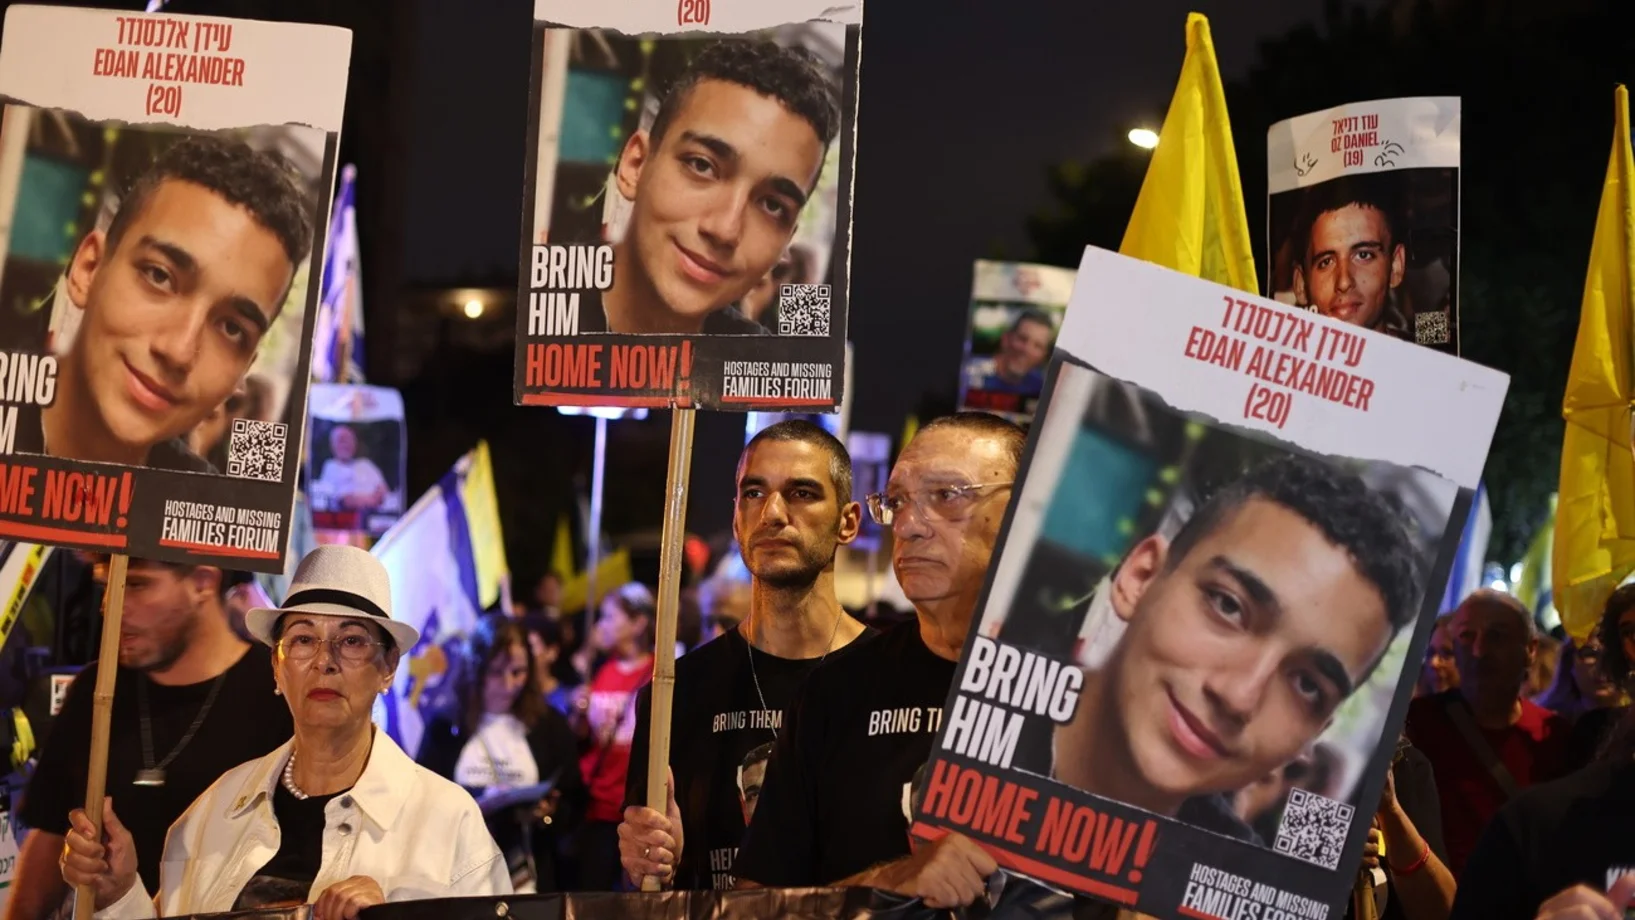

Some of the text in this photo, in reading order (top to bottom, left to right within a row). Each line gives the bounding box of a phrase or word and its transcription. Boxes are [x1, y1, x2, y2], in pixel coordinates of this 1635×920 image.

[677, 0, 710, 26] (20)
[116, 16, 233, 53] עידן אלכסנדר
[93, 48, 245, 86] EDAN ALEXANDER
[146, 83, 182, 118] (20)
[1331, 131, 1379, 153] OZ DANIEL
[1332, 114, 1378, 136] עוז דניאל
[1343, 148, 1363, 168] (19)
[530, 245, 614, 290] BRING
[528, 292, 580, 336] HIM
[1221, 295, 1366, 368] עידן אלכסנדר
[0, 352, 57, 405] RING
[525, 340, 692, 390] HOME NOW!
[723, 361, 832, 378] HOSTAGES AND MISSING
[1184, 325, 1375, 412] EDAN ALEXANDER
[723, 376, 832, 400] FAMILIES FORUM
[1243, 383, 1292, 430] (20)
[42, 469, 133, 528] NOW!
[164, 499, 281, 529] HOSTAGES AND MISSING
[161, 516, 280, 553] FAMILIES FORUM
[960, 635, 1084, 722] BRING
[712, 709, 783, 733] BRING THEM
[868, 708, 922, 736] BRING
[941, 696, 1025, 770] HIM
[921, 759, 1158, 883] HOME NOW!
[1181, 881, 1262, 920] FAMILIES
[1189, 862, 1252, 898] HOSTAGES
[1250, 882, 1277, 906] AND
[1274, 890, 1330, 920] MISSING
